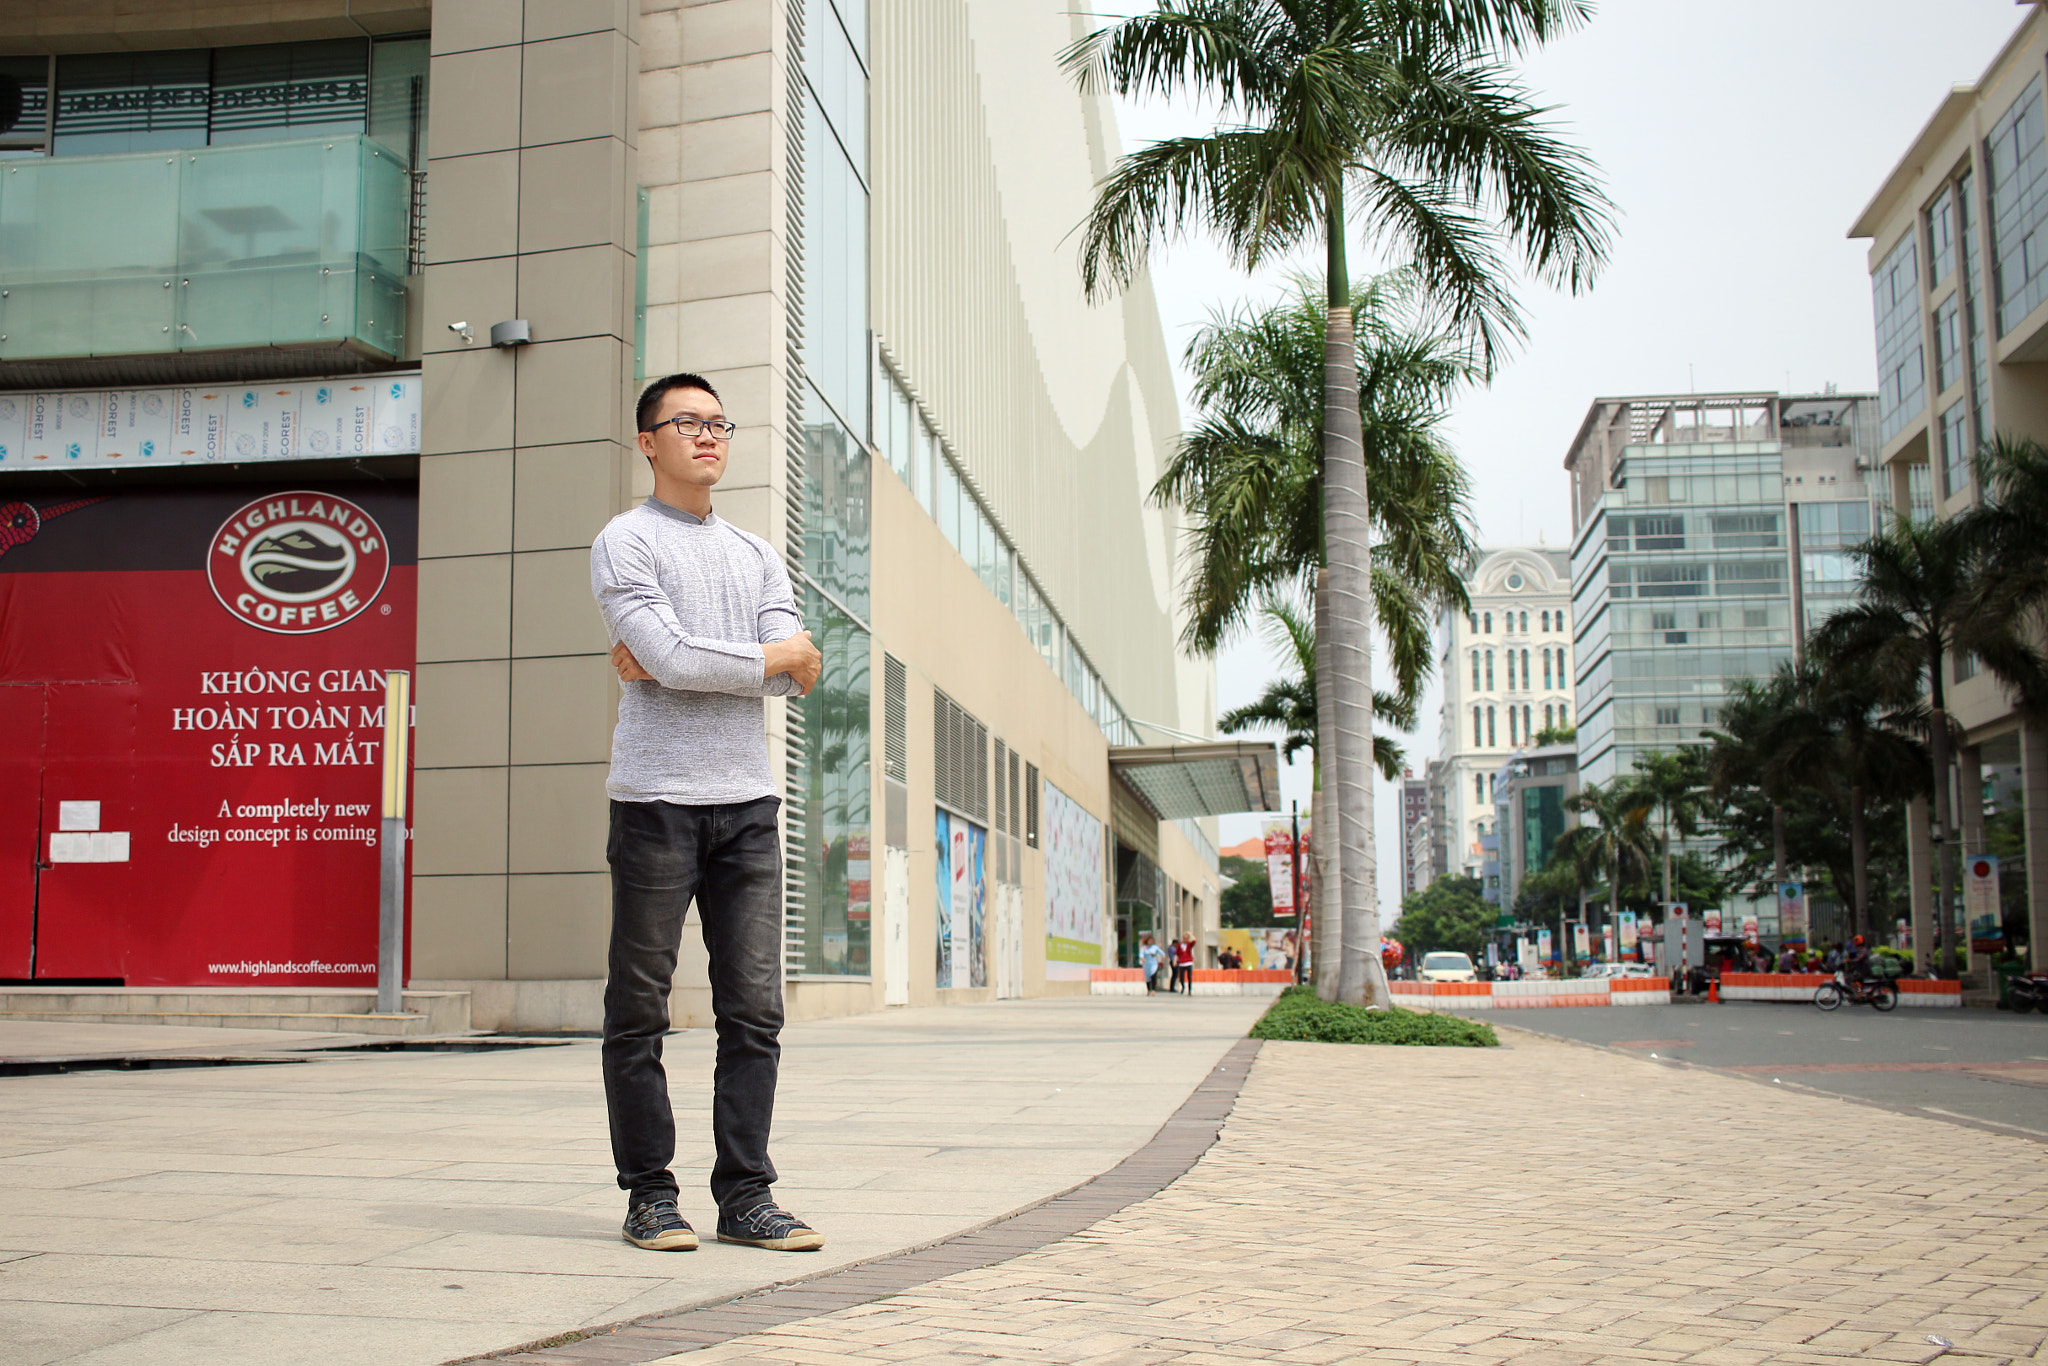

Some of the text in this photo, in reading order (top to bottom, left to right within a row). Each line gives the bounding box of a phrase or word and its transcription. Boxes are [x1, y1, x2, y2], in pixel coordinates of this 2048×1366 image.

[34, 395, 45, 440] COREST
[106, 393, 118, 438] COREST
[181, 390, 192, 435] COREST
[354, 406, 365, 452] COREST
[206, 414, 218, 459] COREST
[280, 410, 292, 456] COREST
[218, 499, 379, 557] HIGHLANDS
[236, 589, 360, 625] COFFEE
[201, 666, 387, 694] KHÔNG GIAN
[172, 701, 259, 730] HOÀN
[267, 700, 351, 729] TOÀN
[211, 731, 379, 767] SẮP RA MẮT
[217, 797, 371, 823] A completely new
[167, 823, 376, 848] design concept is coming
[208, 960, 376, 977] www.highlandscoffee.com.vn
